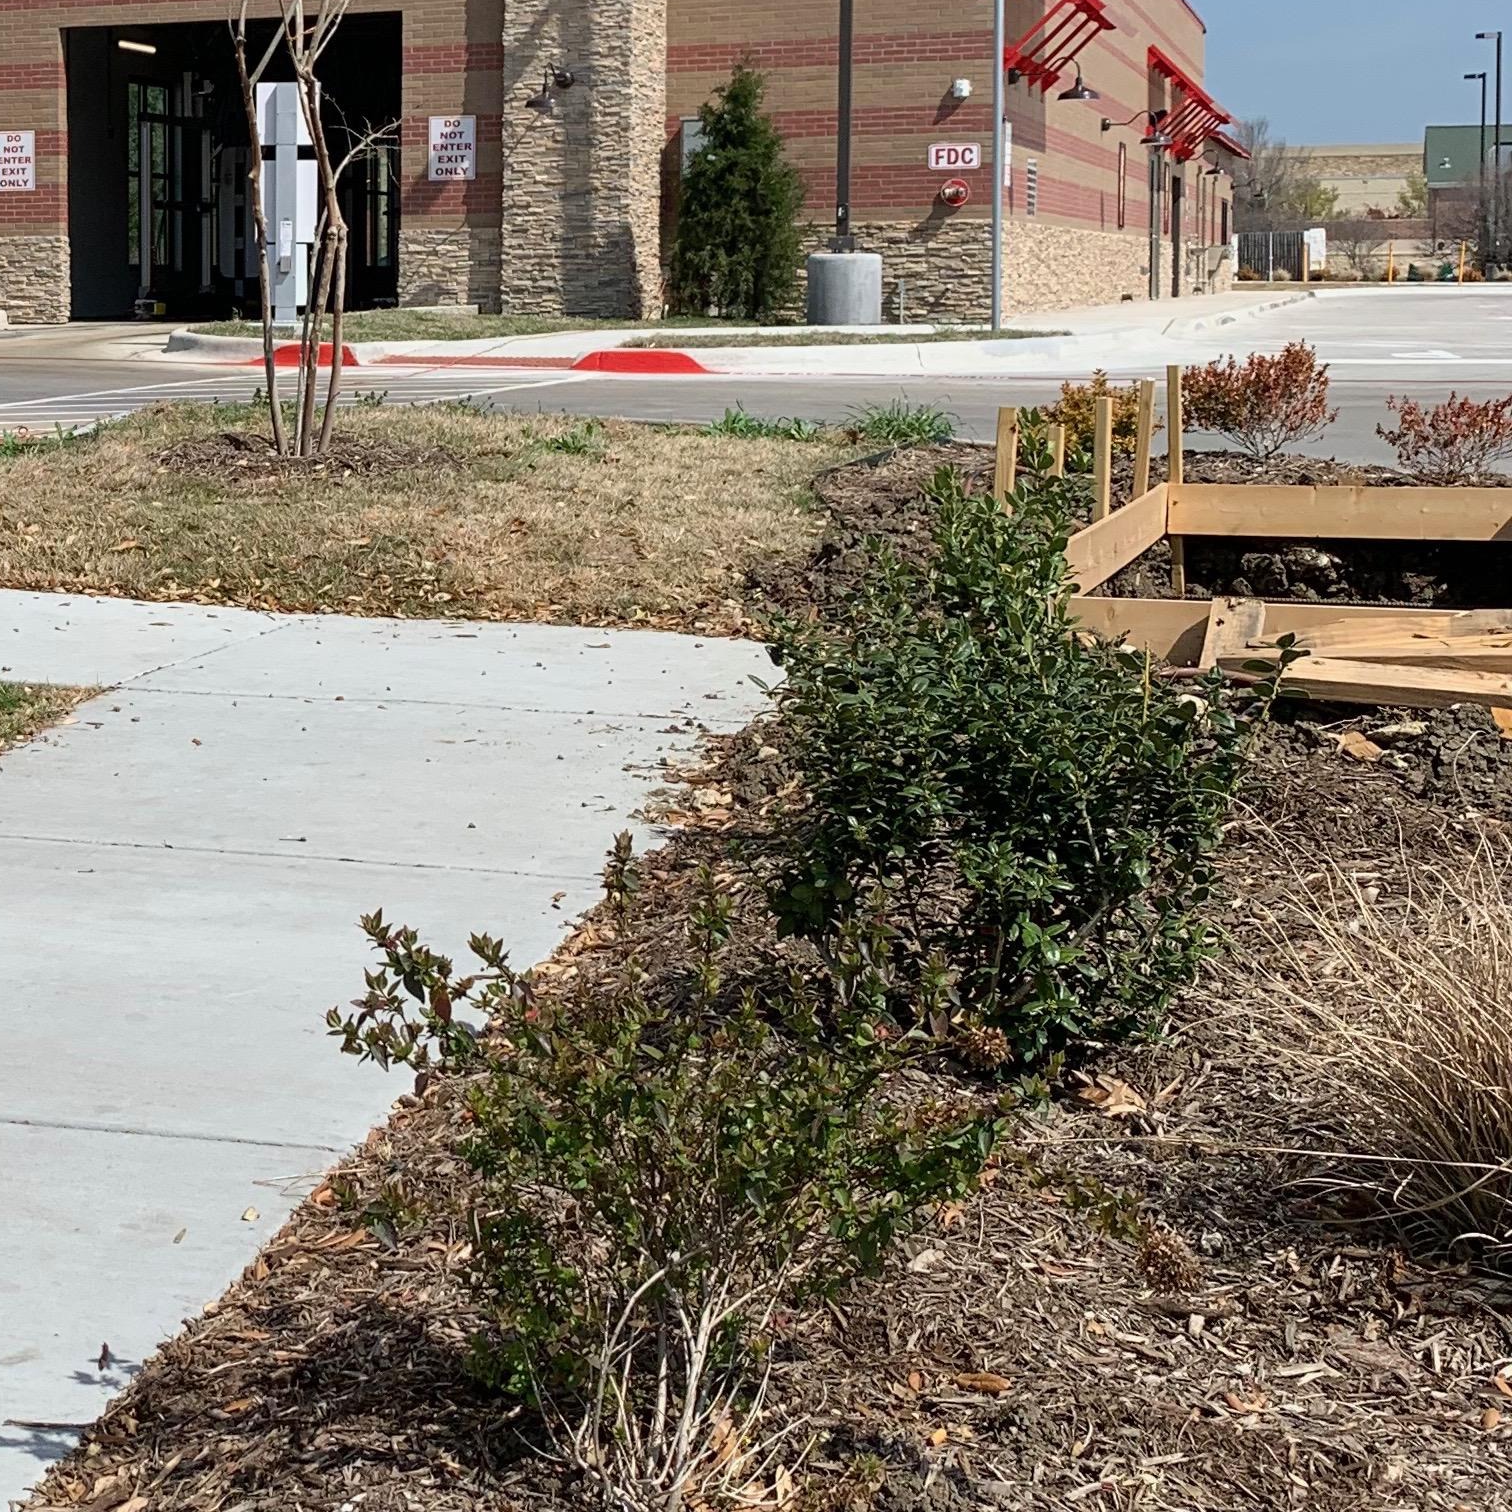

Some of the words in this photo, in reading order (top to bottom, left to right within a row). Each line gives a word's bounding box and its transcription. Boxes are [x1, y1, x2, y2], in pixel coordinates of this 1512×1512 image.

[440, 131, 464, 139] NOT
[433, 143, 472, 151] ENTER
[438, 155, 466, 163] EXIT
[935, 148, 974, 165] FDC
[435, 167, 468, 176] ONLY
[0, 179, 29, 187] ONLY
